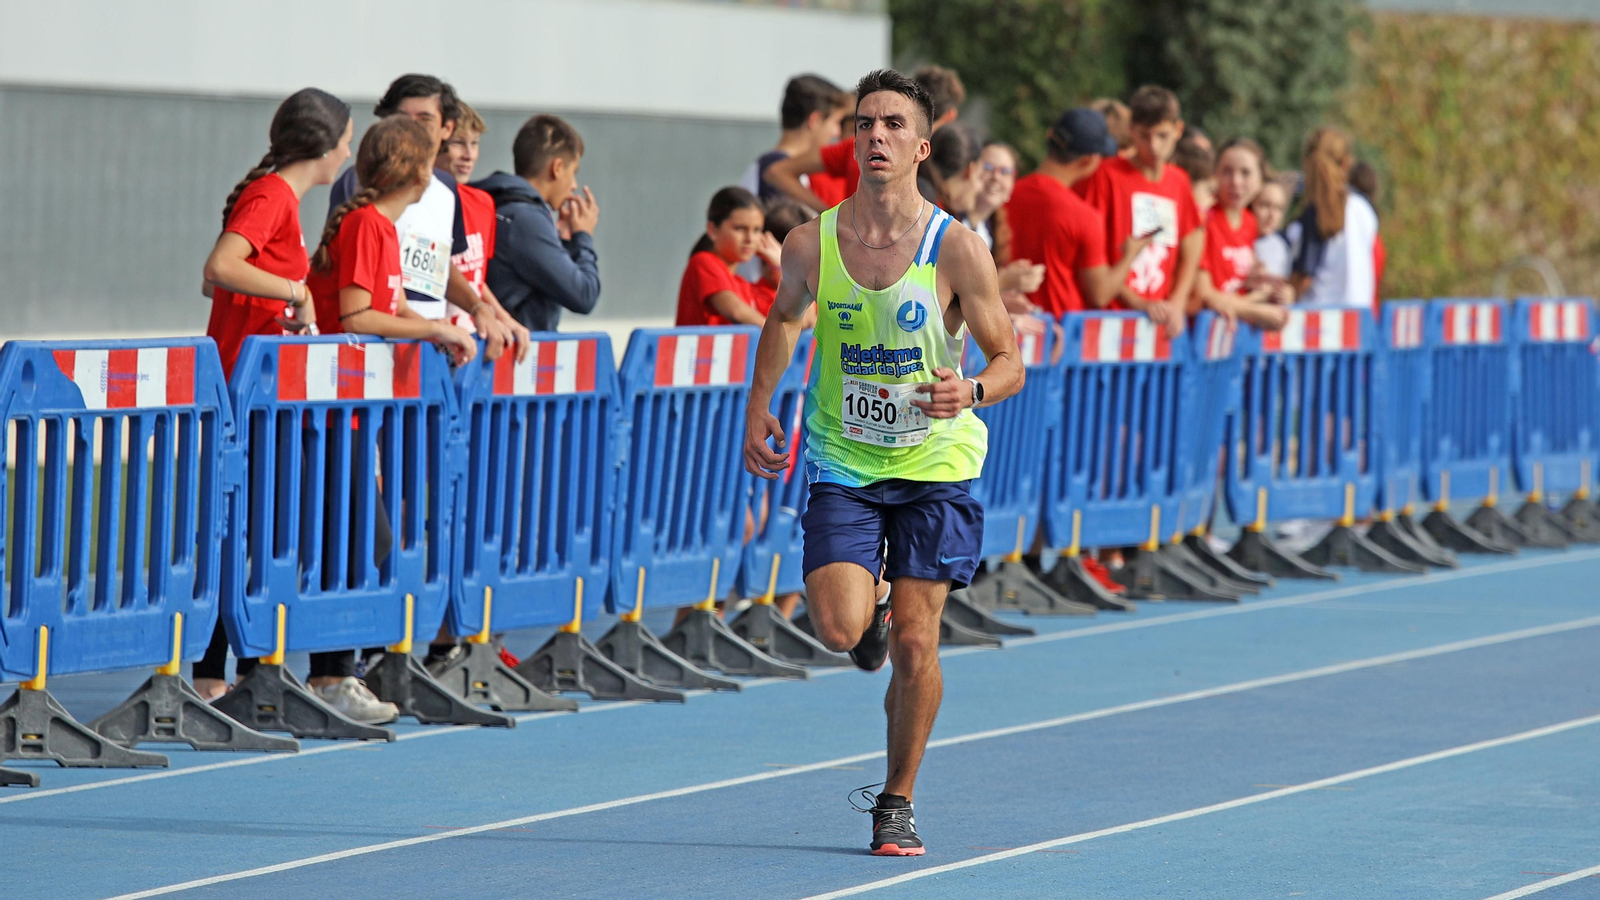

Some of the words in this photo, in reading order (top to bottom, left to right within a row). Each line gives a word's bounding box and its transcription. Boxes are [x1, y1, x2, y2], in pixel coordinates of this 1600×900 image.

[403, 246, 436, 274] 1680
[841, 342, 922, 364] Atletismo
[841, 360, 877, 376] Ciudad
[878, 362, 894, 375] de
[895, 362, 924, 378] Jerez
[845, 393, 897, 425] 1050
